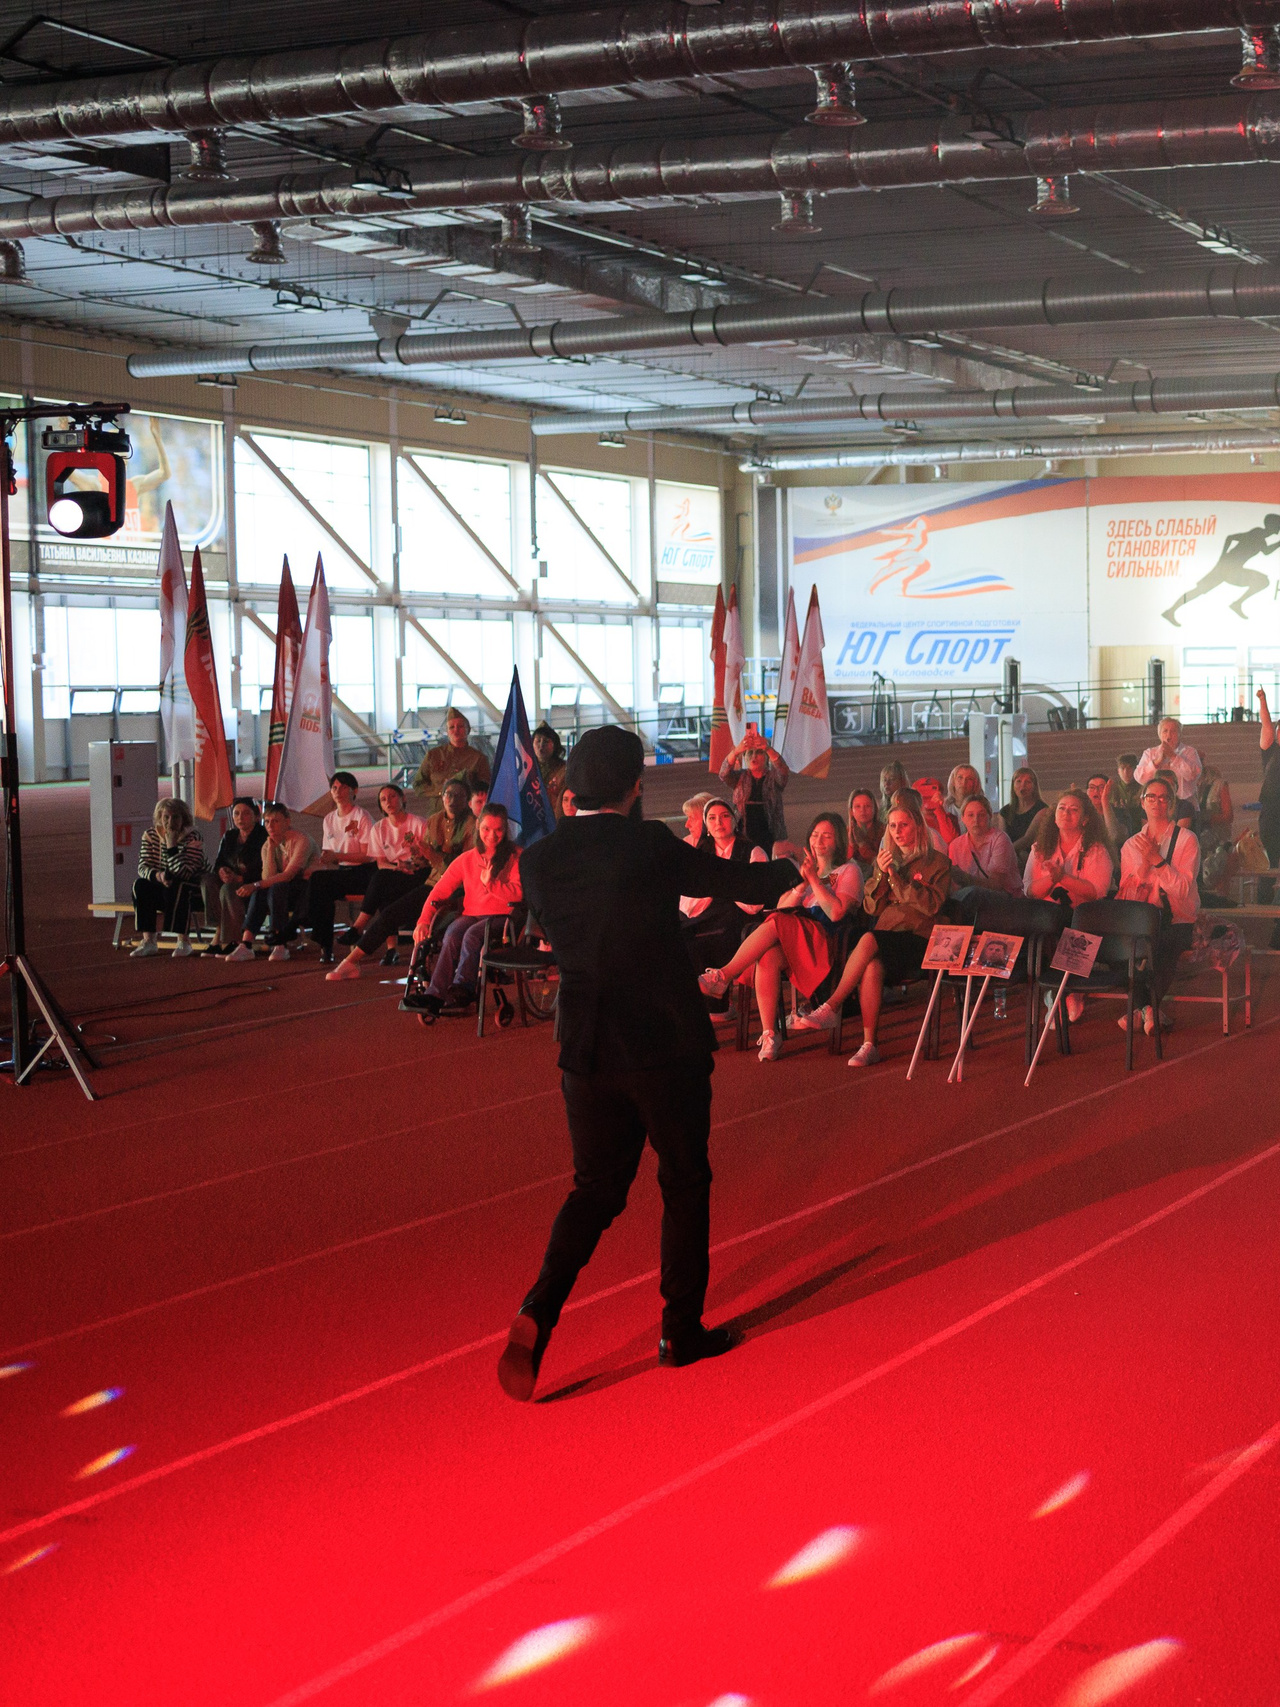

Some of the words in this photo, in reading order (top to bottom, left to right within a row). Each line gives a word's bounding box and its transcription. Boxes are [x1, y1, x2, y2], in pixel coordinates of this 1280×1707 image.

[1107, 520, 1151, 539] ЗДЕСЬ
[1156, 515, 1217, 537] СЛАБЫЙ
[39, 544, 75, 560] ТАТЬЯНА
[76, 547, 127, 562] ВАСИЛЬЕВНА
[1107, 539, 1197, 558] СТАНОВИТСЯ
[661, 546, 681, 565] ЮГ
[682, 548, 715, 572] Спорт
[927, 620, 973, 628] СПОРТИВНОЙ
[975, 620, 1021, 628] ПОДГОТОВКИ
[836, 630, 901, 666] ЮГ
[905, 629, 1015, 672] Спорт
[834, 668, 873, 678] Филиал
[893, 667, 955, 678] Кисловодске
[799, 704, 823, 719] ПОБЕД
